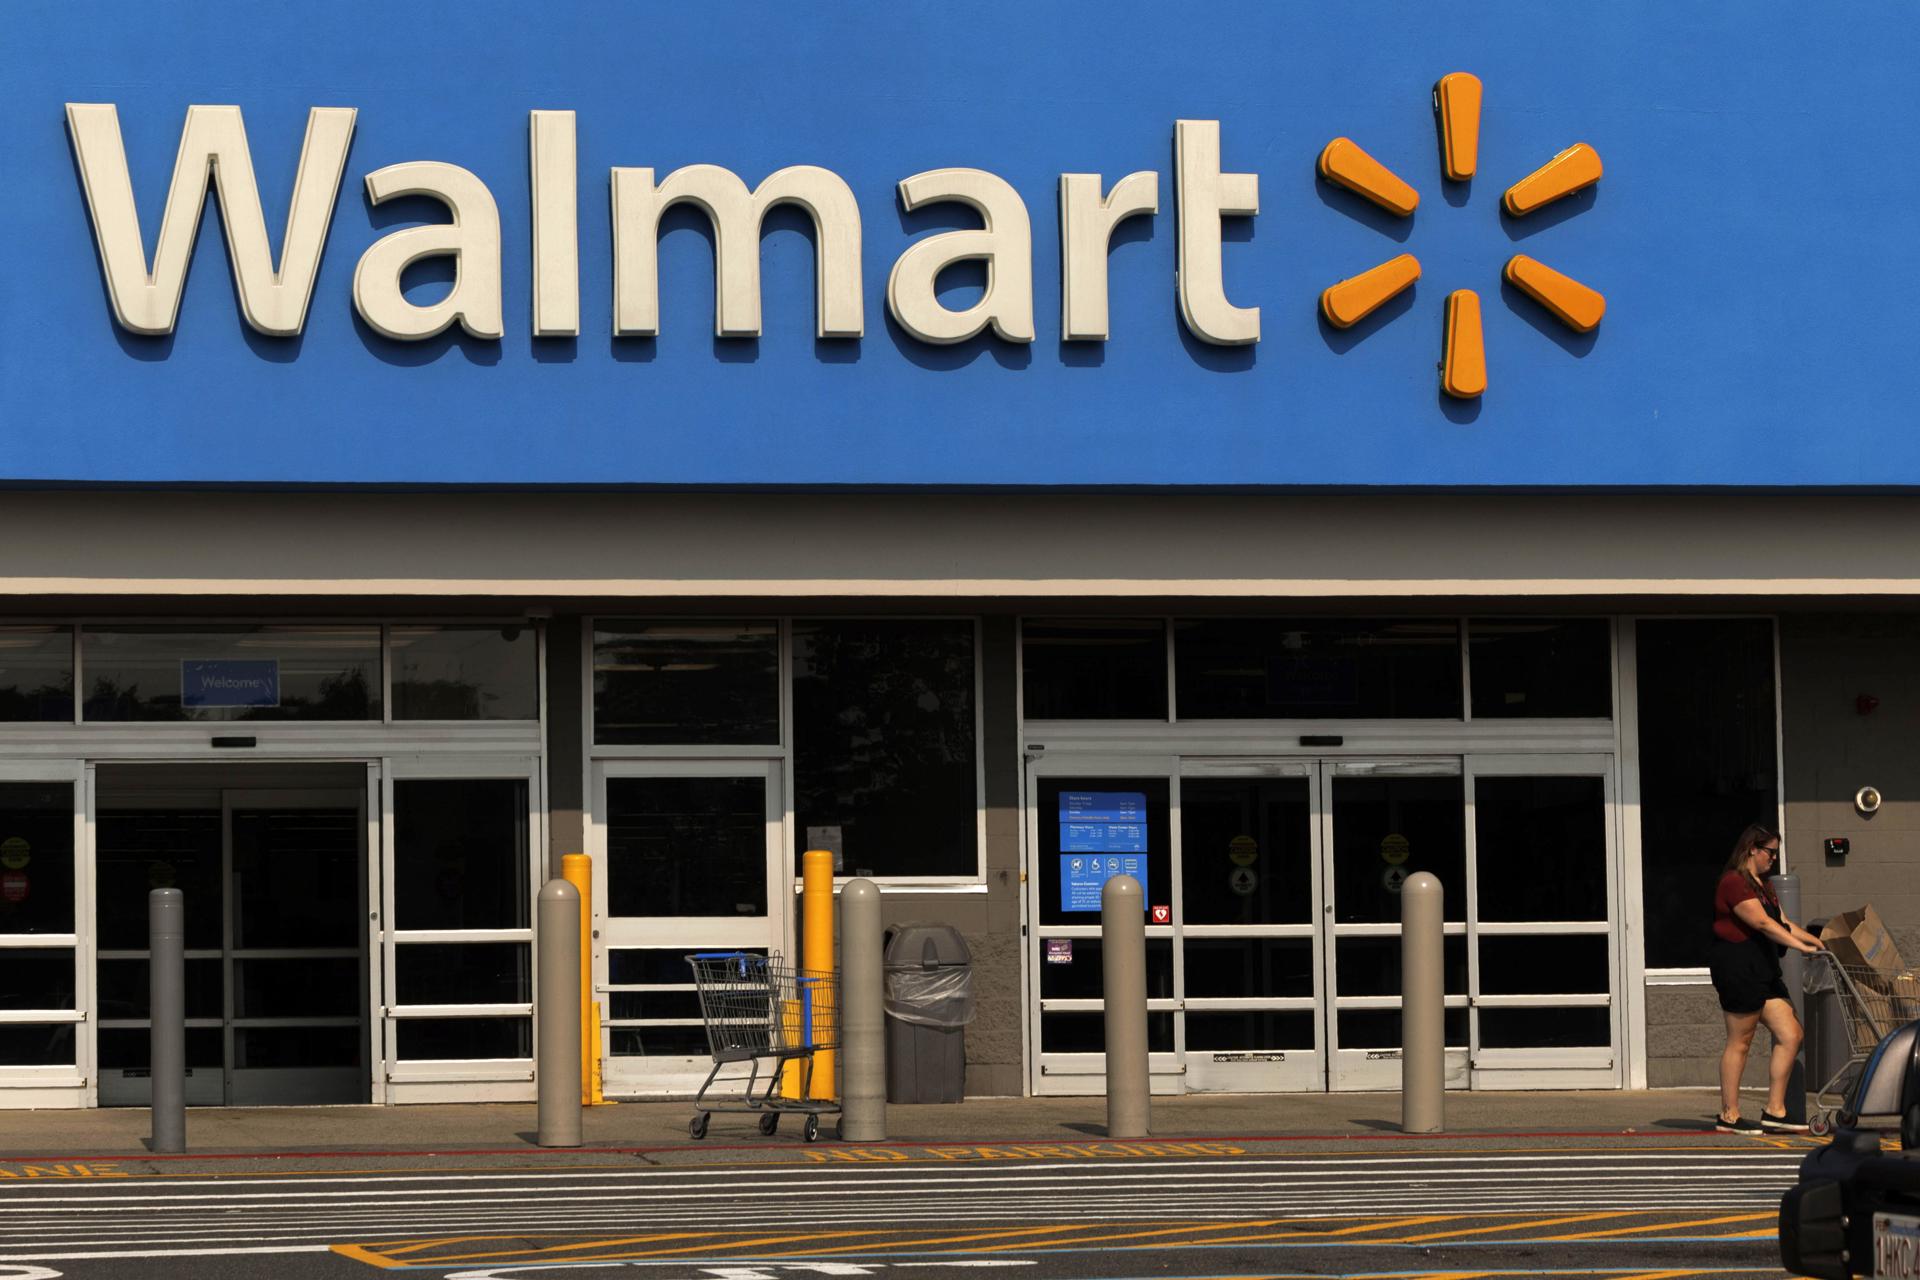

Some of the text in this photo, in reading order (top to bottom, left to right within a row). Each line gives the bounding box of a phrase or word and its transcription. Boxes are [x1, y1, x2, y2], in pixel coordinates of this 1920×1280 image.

[64, 102, 1261, 346] Walmart
[201, 676, 260, 689] Welcome
[801, 1143, 1245, 1161] NO PARKING
